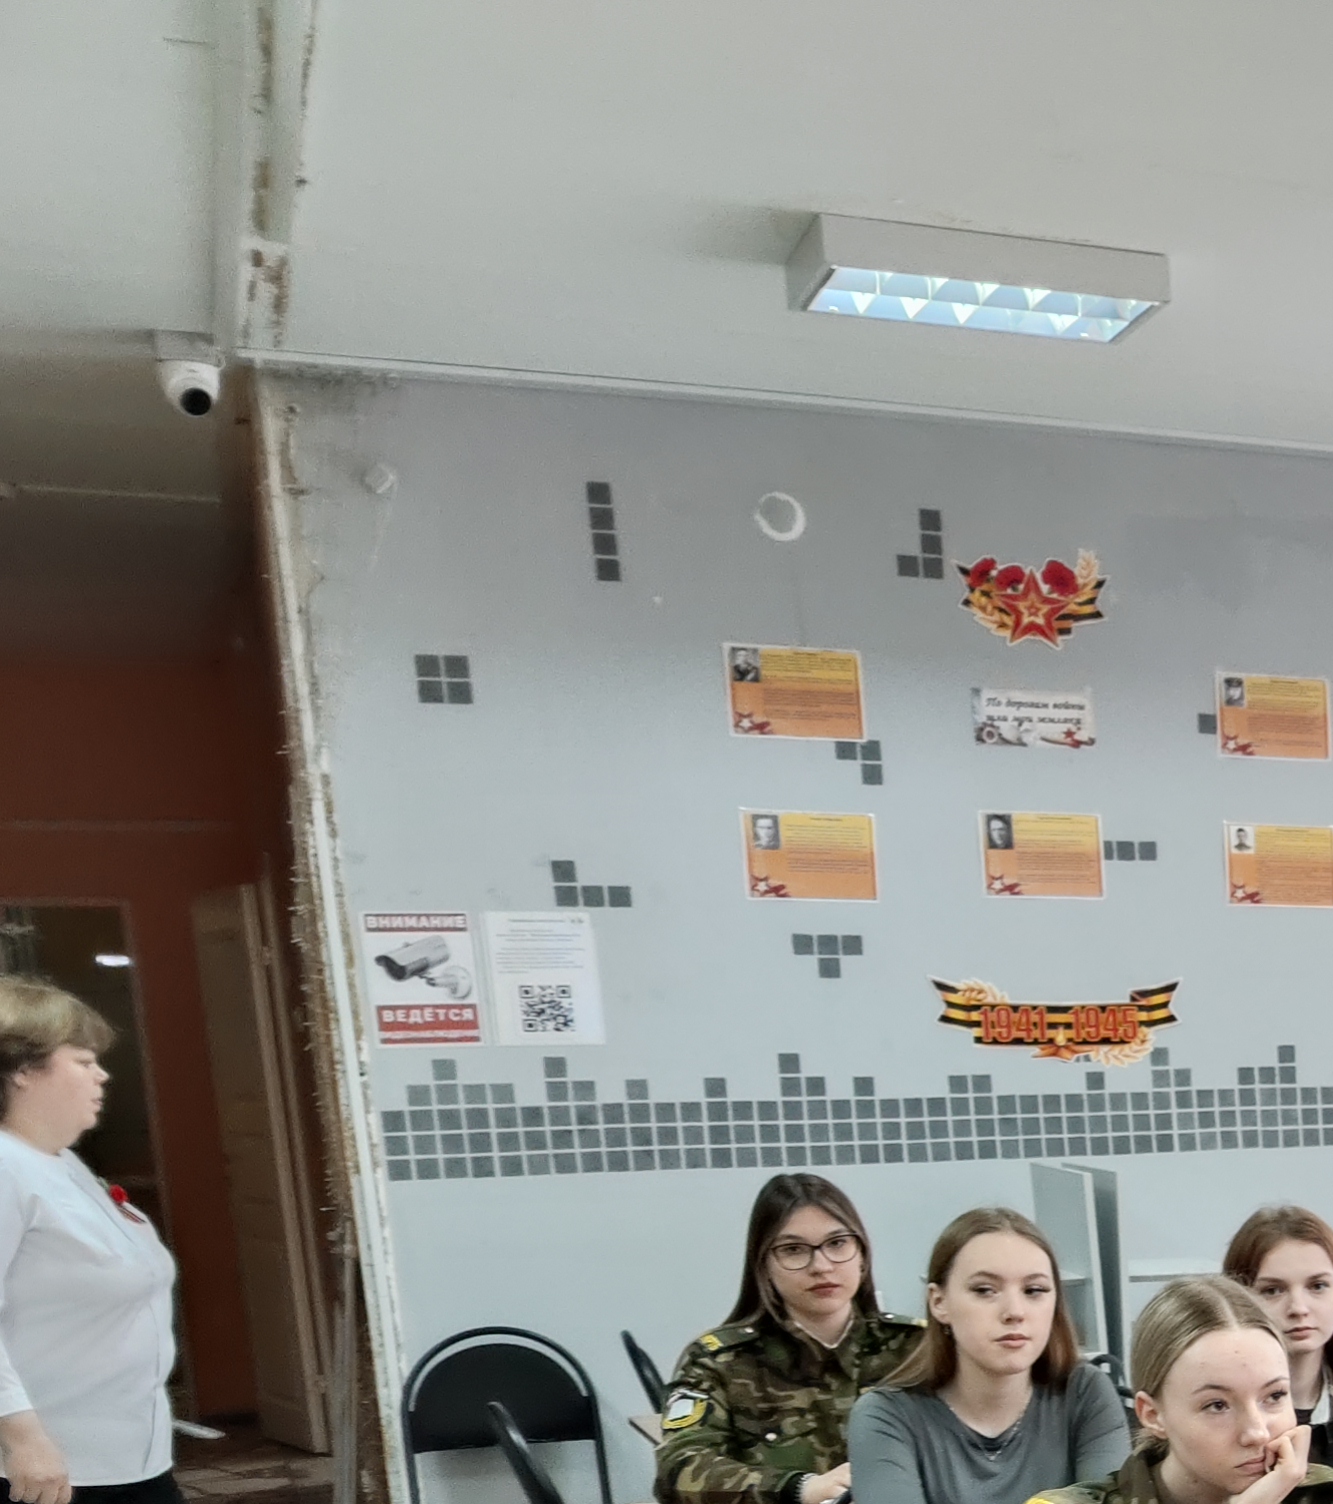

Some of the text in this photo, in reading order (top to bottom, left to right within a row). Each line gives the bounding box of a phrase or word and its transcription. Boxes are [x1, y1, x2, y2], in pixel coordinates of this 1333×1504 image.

[365, 915, 467, 929] ВНИМАНИЕ
[381, 1007, 475, 1024] ВЕДЁТСЯ
[980, 1005, 1138, 1042] 1941 1945
